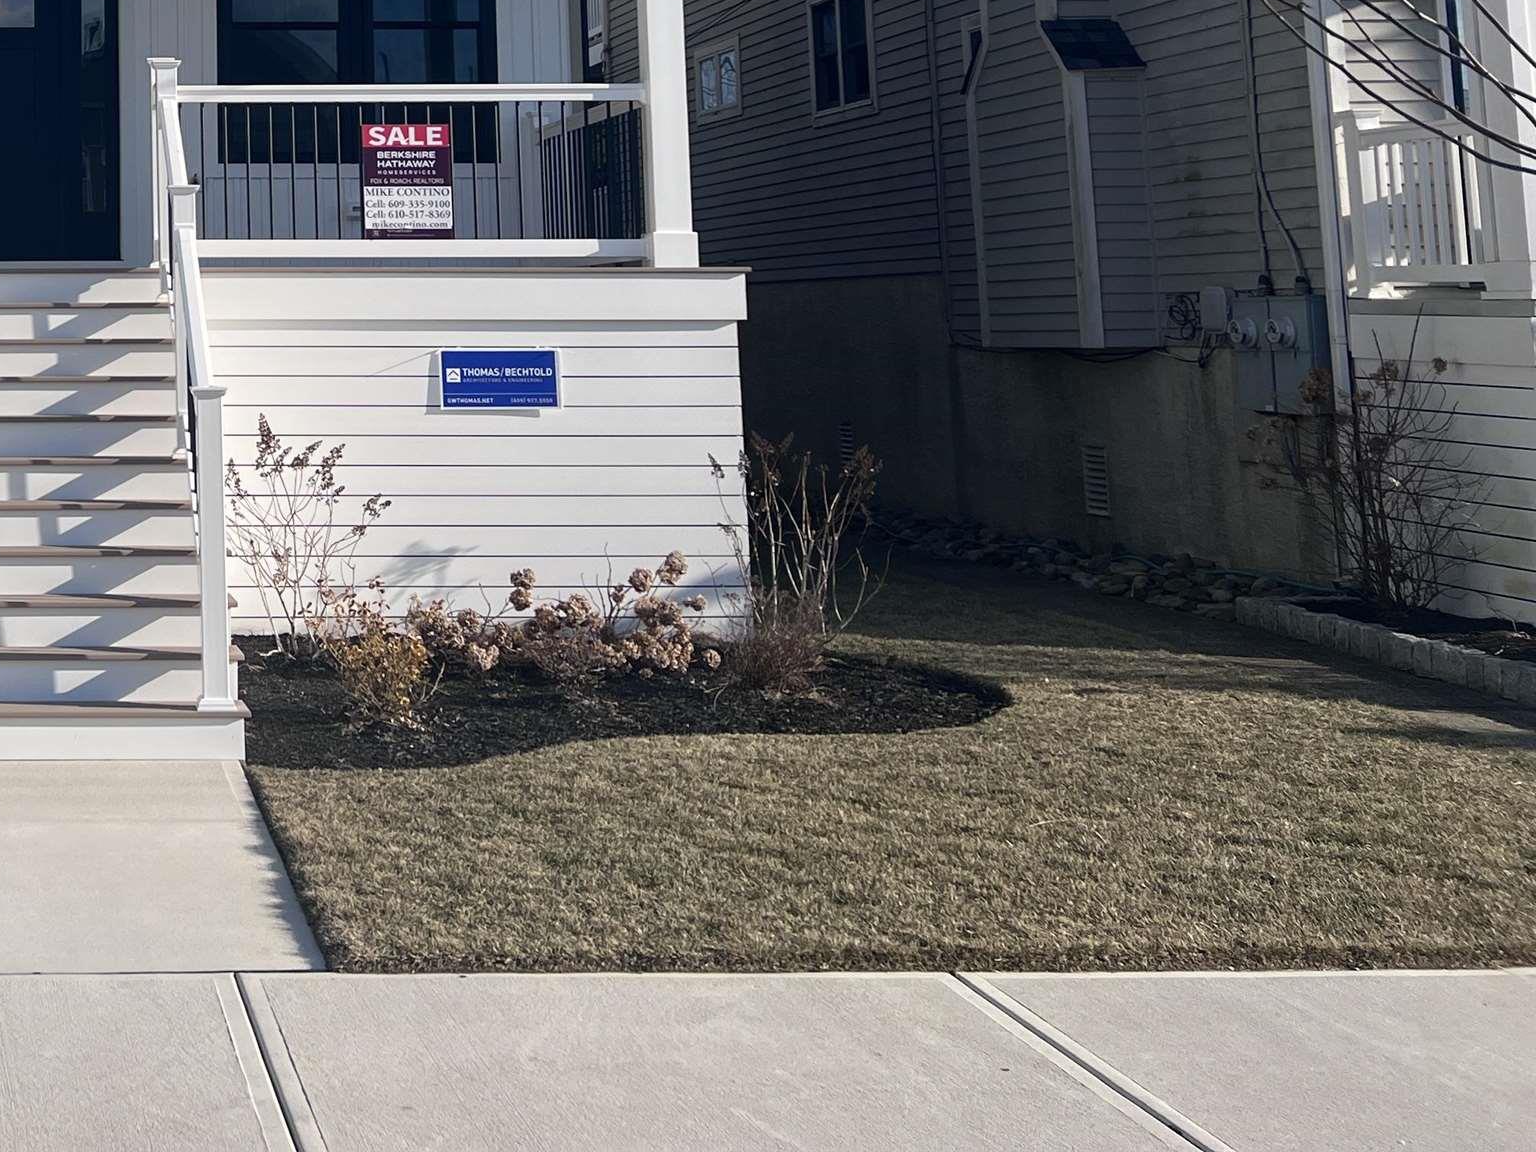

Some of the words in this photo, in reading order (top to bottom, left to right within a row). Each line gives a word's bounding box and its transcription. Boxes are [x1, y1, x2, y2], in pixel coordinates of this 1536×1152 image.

[368, 126, 443, 146] SALE
[376, 151, 436, 159] BERKSHIRE
[377, 160, 436, 168] HATHAWAY
[365, 188, 396, 196] MIKE
[396, 188, 450, 196] CONTINO
[366, 200, 386, 208] Cell:
[388, 200, 450, 208] 609-335-9100
[366, 210, 386, 218] Cell:
[388, 210, 451, 218] 610-517-8369
